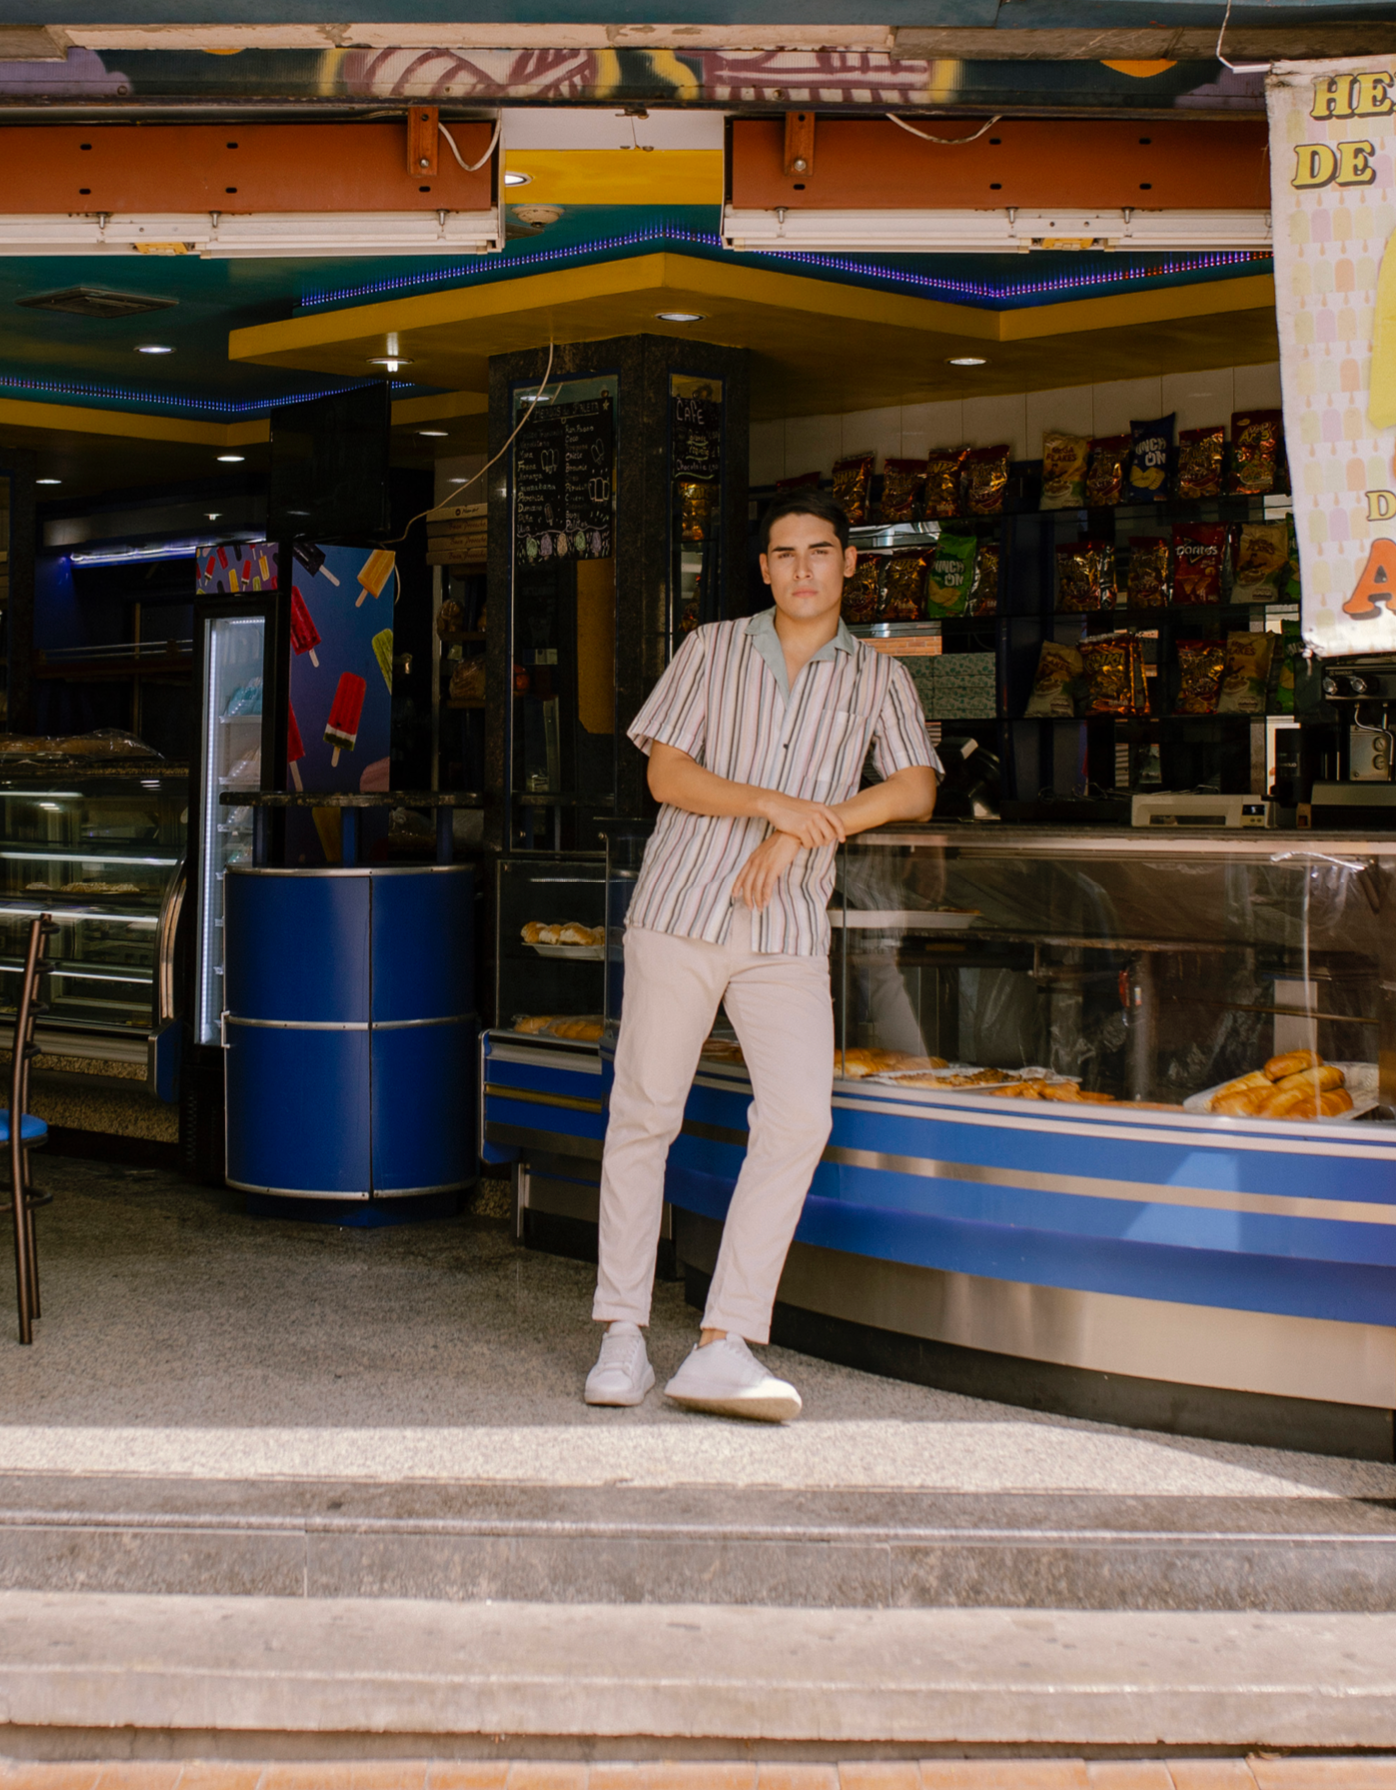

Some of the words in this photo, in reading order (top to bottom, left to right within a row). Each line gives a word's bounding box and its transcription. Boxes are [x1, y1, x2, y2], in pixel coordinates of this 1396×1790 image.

[1310, 71, 1396, 121] HE
[1291, 140, 1376, 190] DE
[1145, 451, 1166, 467] ON
[944, 573, 964, 586] ON
